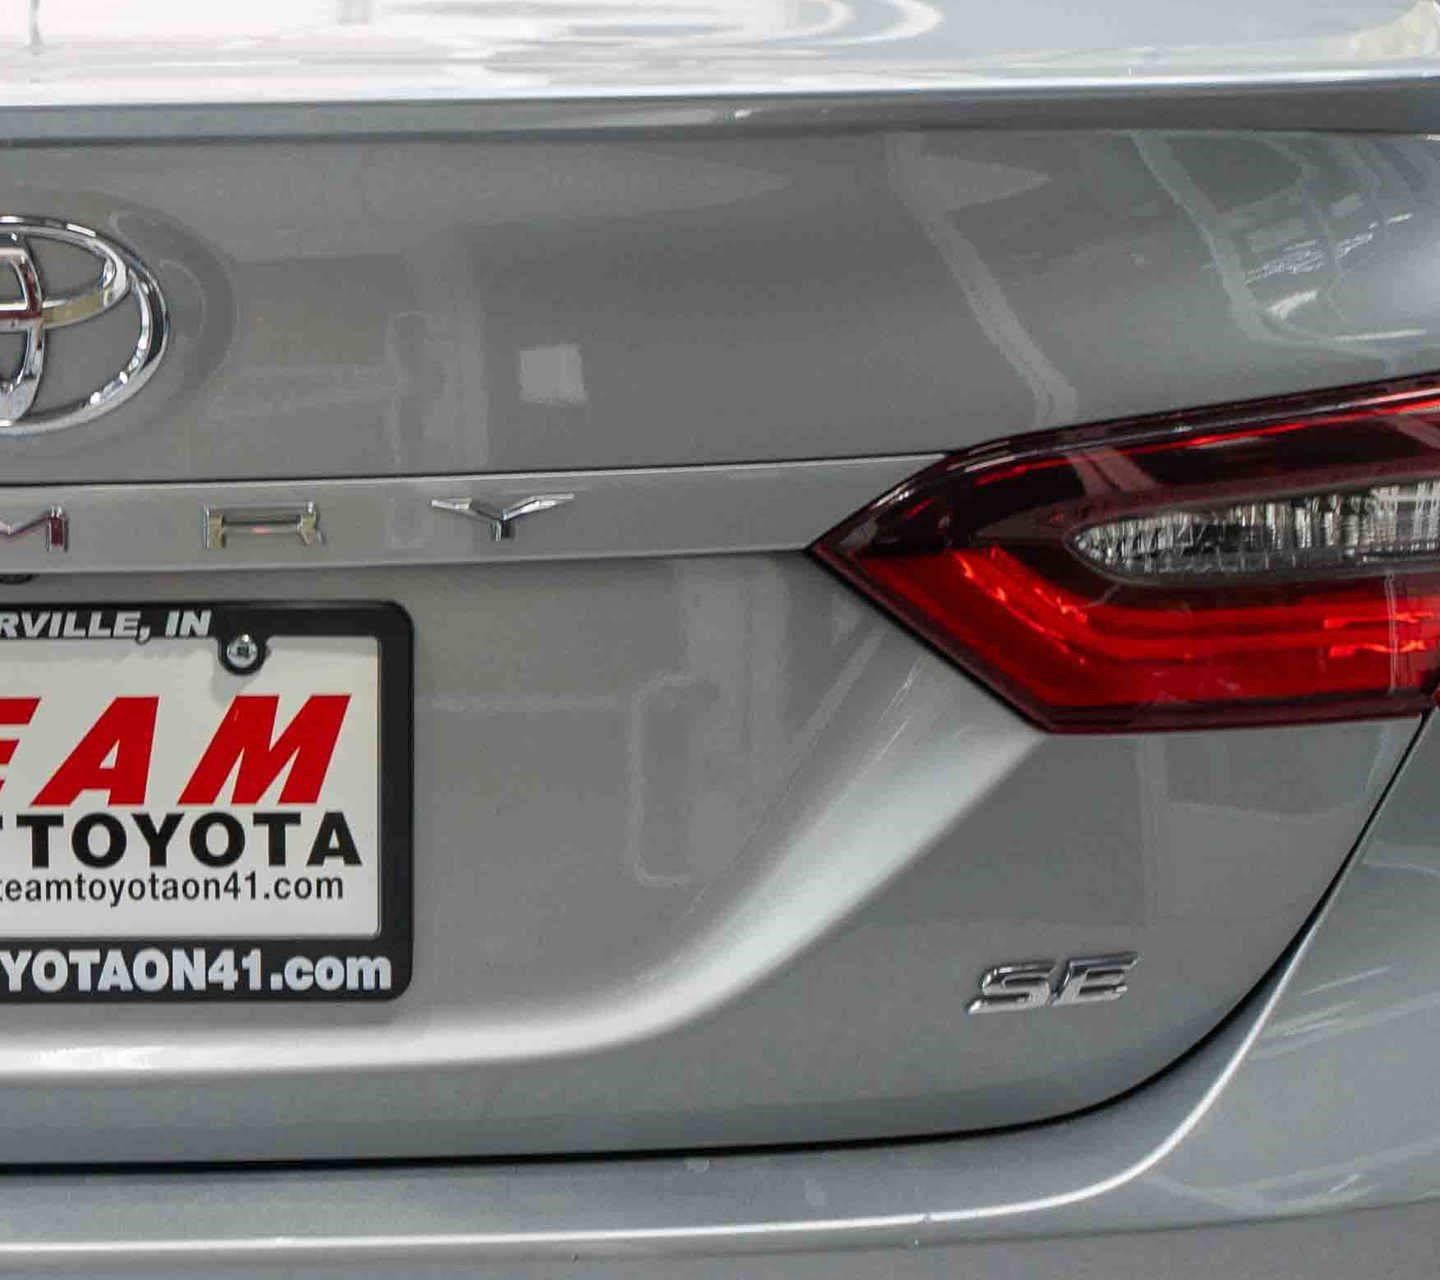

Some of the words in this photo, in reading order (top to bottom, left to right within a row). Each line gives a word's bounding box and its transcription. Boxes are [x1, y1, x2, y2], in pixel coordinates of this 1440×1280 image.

[164, 610, 212, 638] IN
[16, 812, 363, 869] TOYOTA
[964, 950, 1144, 1015] SE
